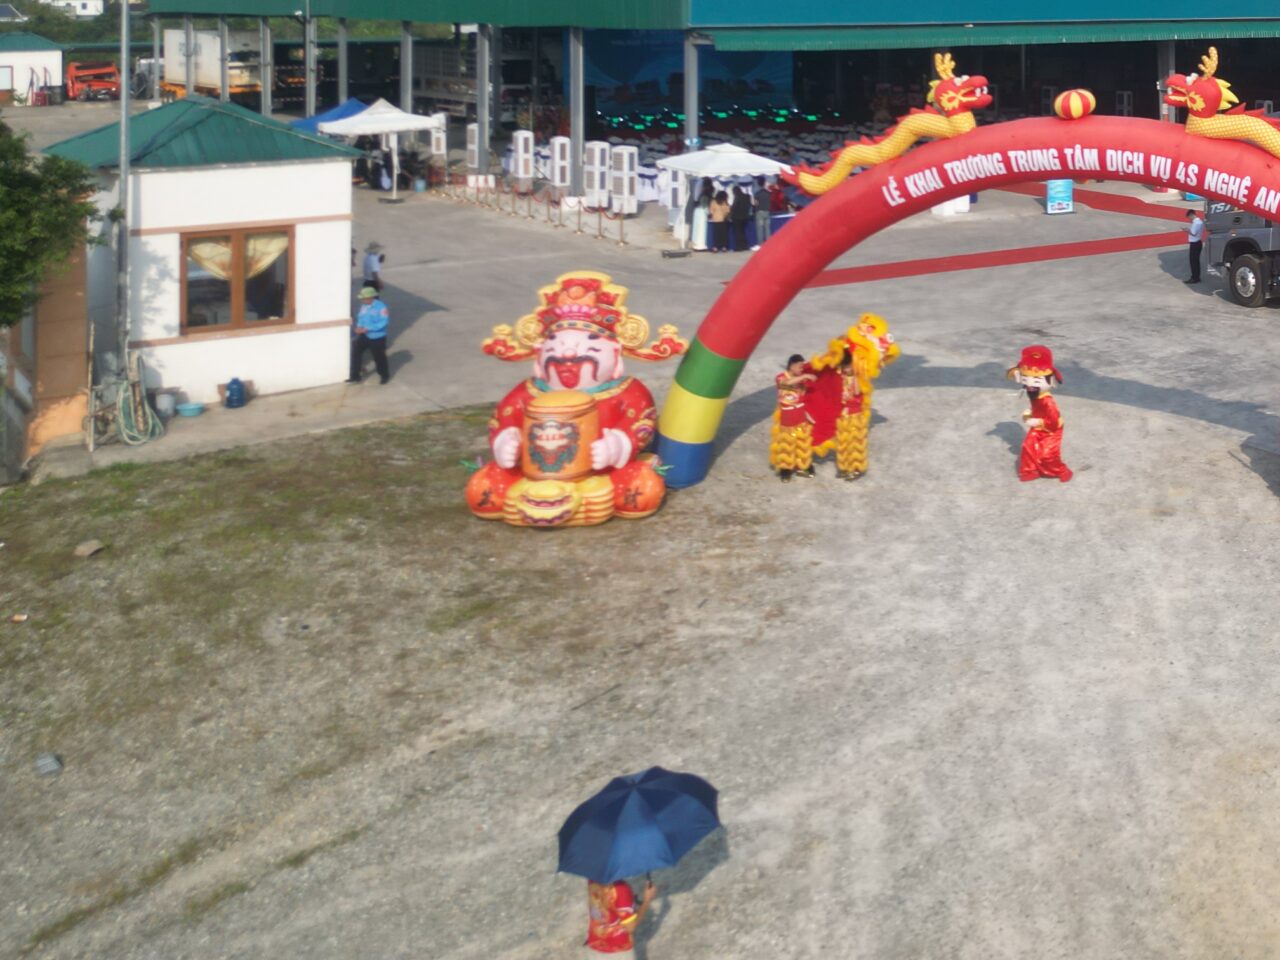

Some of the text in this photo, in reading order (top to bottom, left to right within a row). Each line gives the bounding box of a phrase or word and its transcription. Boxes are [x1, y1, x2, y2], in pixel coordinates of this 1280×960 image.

[904, 166, 945, 198] KHAI
[943, 152, 1008, 185] TRƯƠNG
[1007, 147, 1062, 173] TRUNG
[1063, 144, 1099, 170] TÂM
[1106, 148, 1144, 175] DỊCH
[1150, 155, 1171, 183] VỤ
[1175, 162, 1198, 187] 4S
[1204, 168, 1251, 205] NGHỆ
